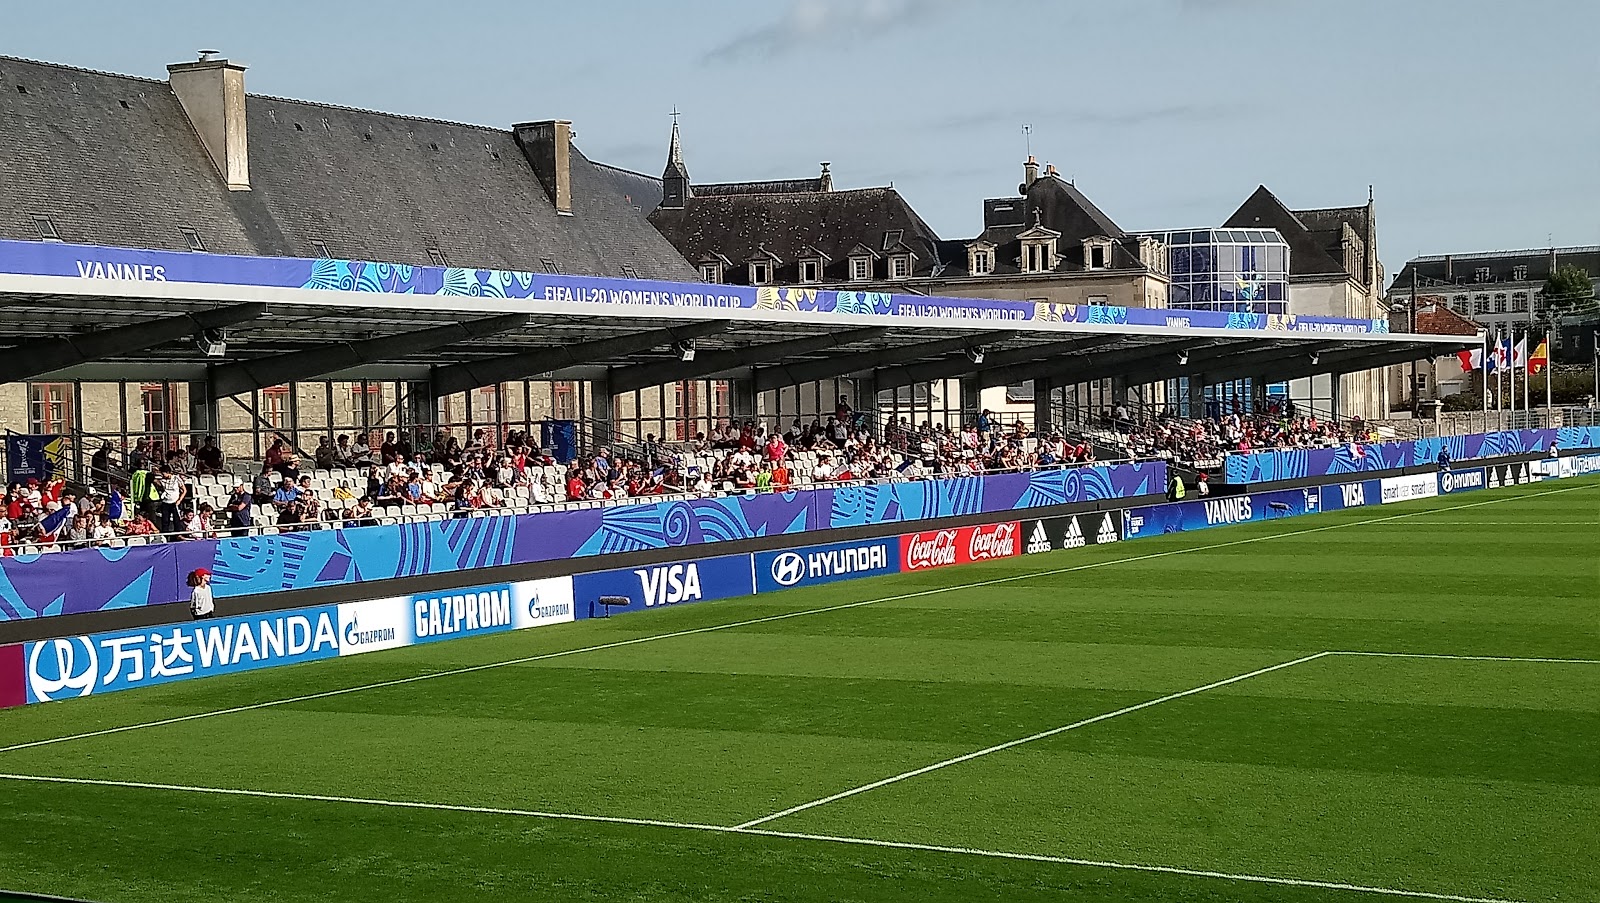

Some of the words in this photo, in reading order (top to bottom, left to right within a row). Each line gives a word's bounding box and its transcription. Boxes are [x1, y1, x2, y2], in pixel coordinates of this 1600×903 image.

[76, 260, 167, 281] VANNES
[544, 286, 573, 302] FIFA
[577, 287, 607, 303] U-20
[610, 289, 670, 306] WOMEN'S
[672, 293, 715, 308] WORLD
[717, 295, 740, 309] CUP
[898, 304, 917, 317] FIFA
[918, 304, 938, 318] U-20
[979, 308, 1008, 321] WORLD
[1009, 309, 1026, 322] CUP
[1453, 471, 1482, 489] HYUNDAI
[1340, 483, 1364, 507] VISA
[1204, 496, 1252, 525] VANNES
[1027, 542, 1051, 554] adidas
[1063, 536, 1086, 549] adidas
[1097, 532, 1118, 544] adidas
[808, 545, 887, 578] HYUNDAI
[634, 563, 702, 607] VISA
[414, 589, 510, 638] GAZPROM
[541, 603, 569, 618] GAZPROM
[360, 627, 395, 645] GAZPROM
[100, 628, 194, 685] 万达
[195, 612, 338, 668] WANDA
